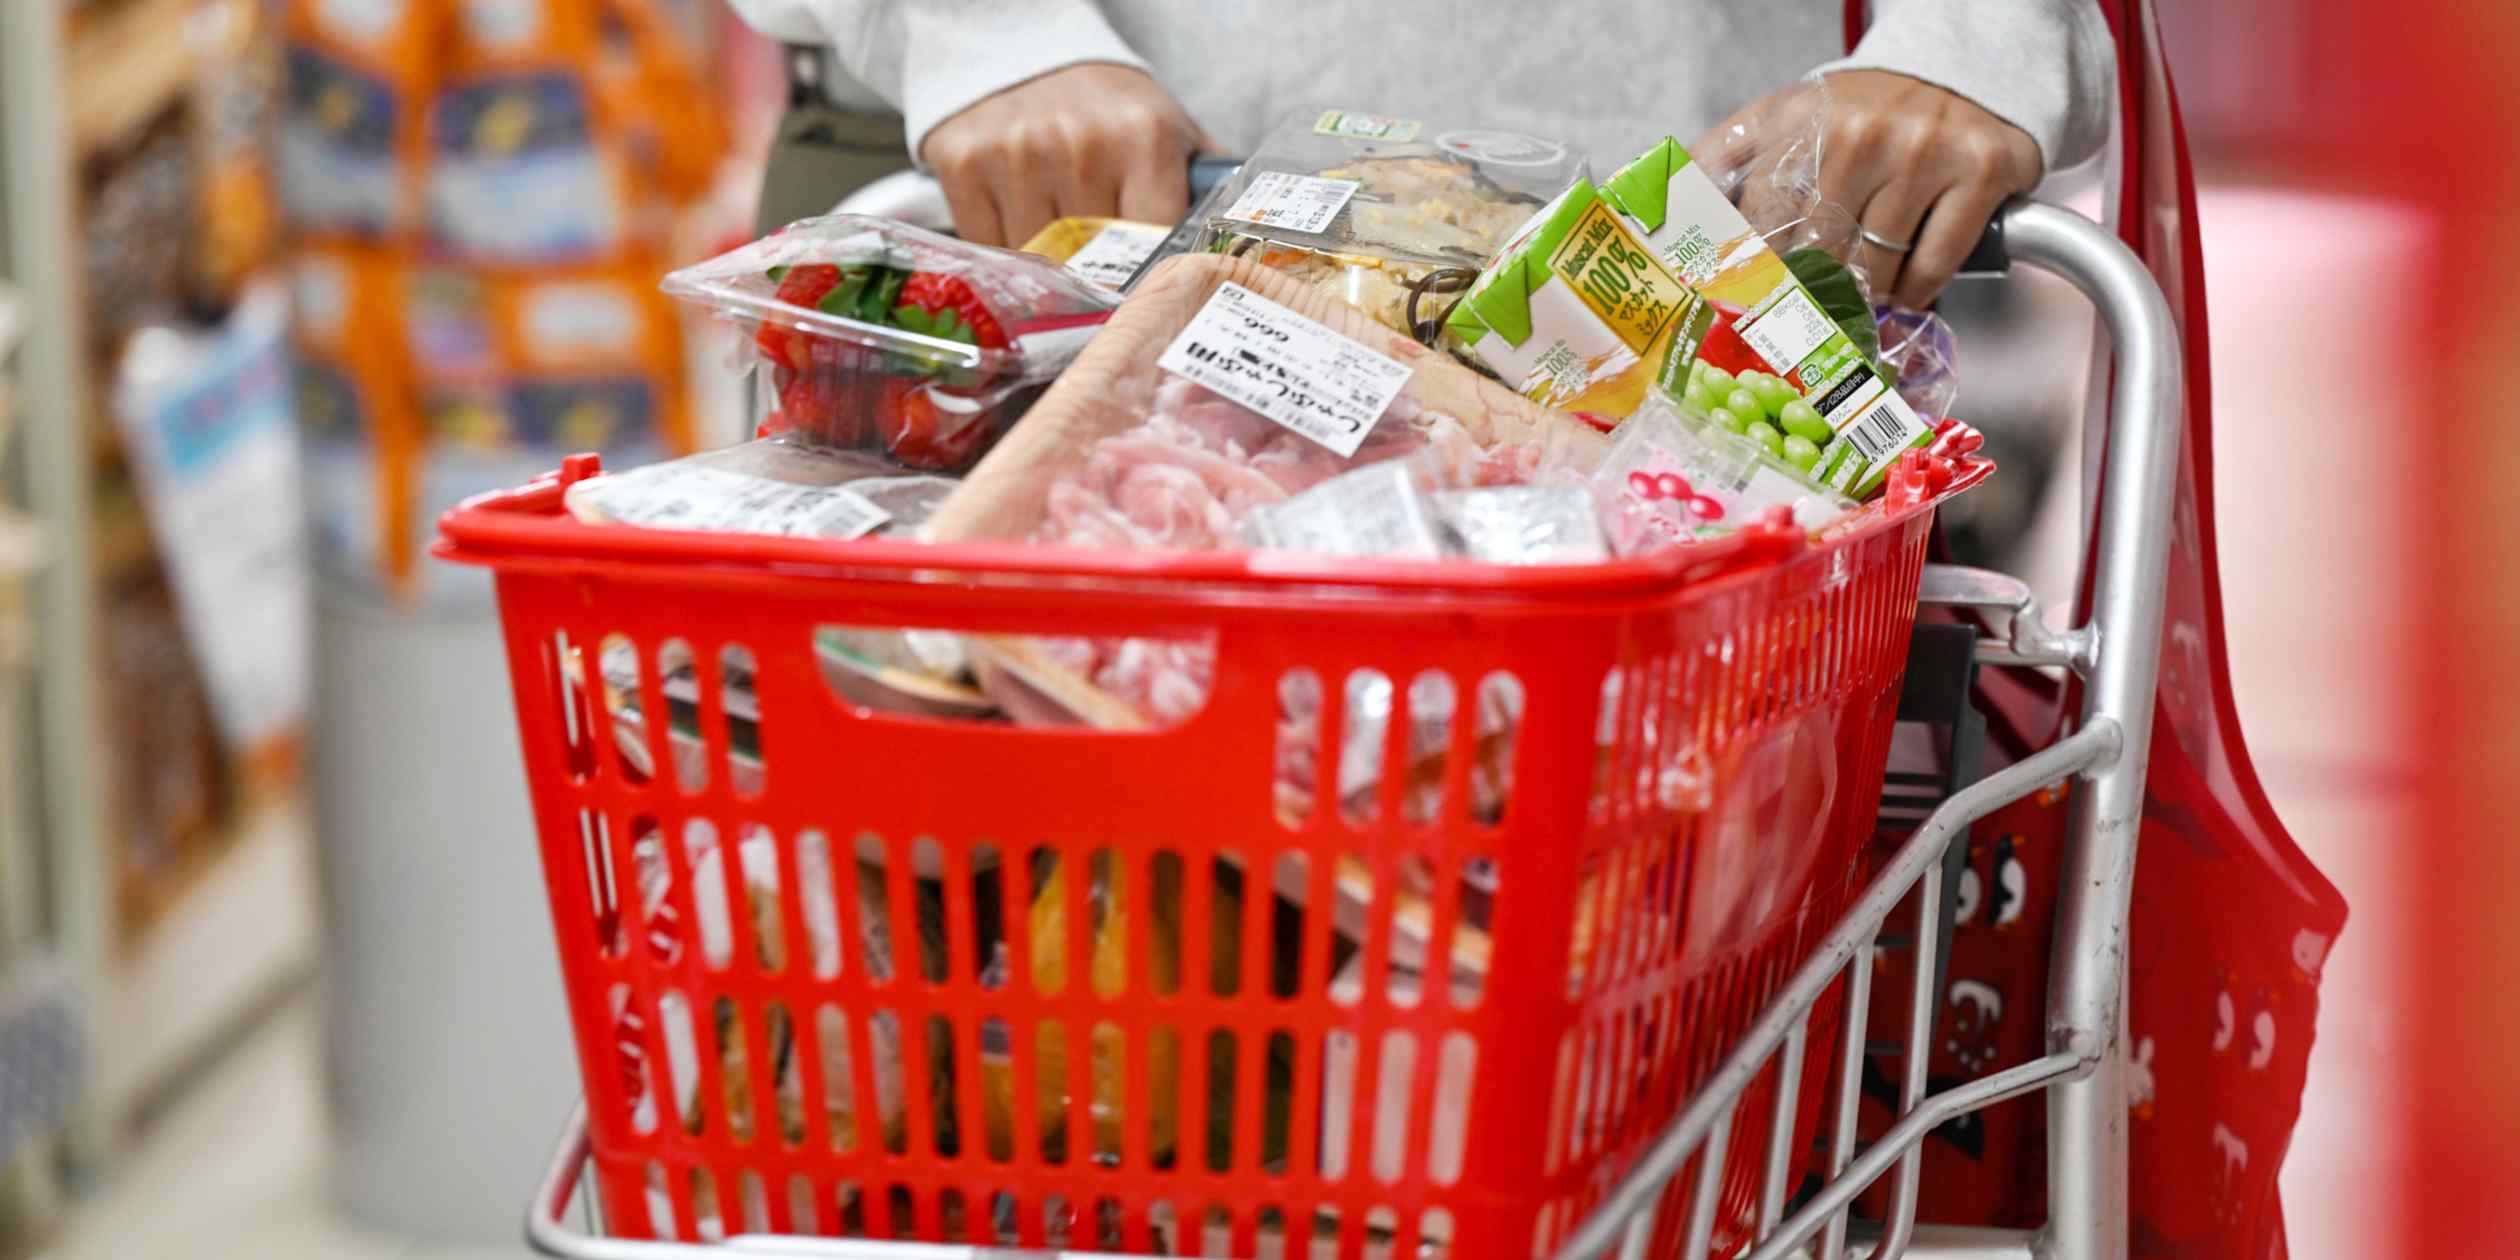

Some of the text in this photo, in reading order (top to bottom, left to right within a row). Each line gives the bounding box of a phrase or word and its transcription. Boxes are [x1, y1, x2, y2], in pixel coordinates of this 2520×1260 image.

[1675, 231, 1712, 265] 100%
[1583, 235, 1648, 315] 100%
[1619, 278, 1655, 320] マスカット
[1636, 300, 1669, 336] ミックス
[1186, 341, 1361, 433] しゃぶしゃぶ用
